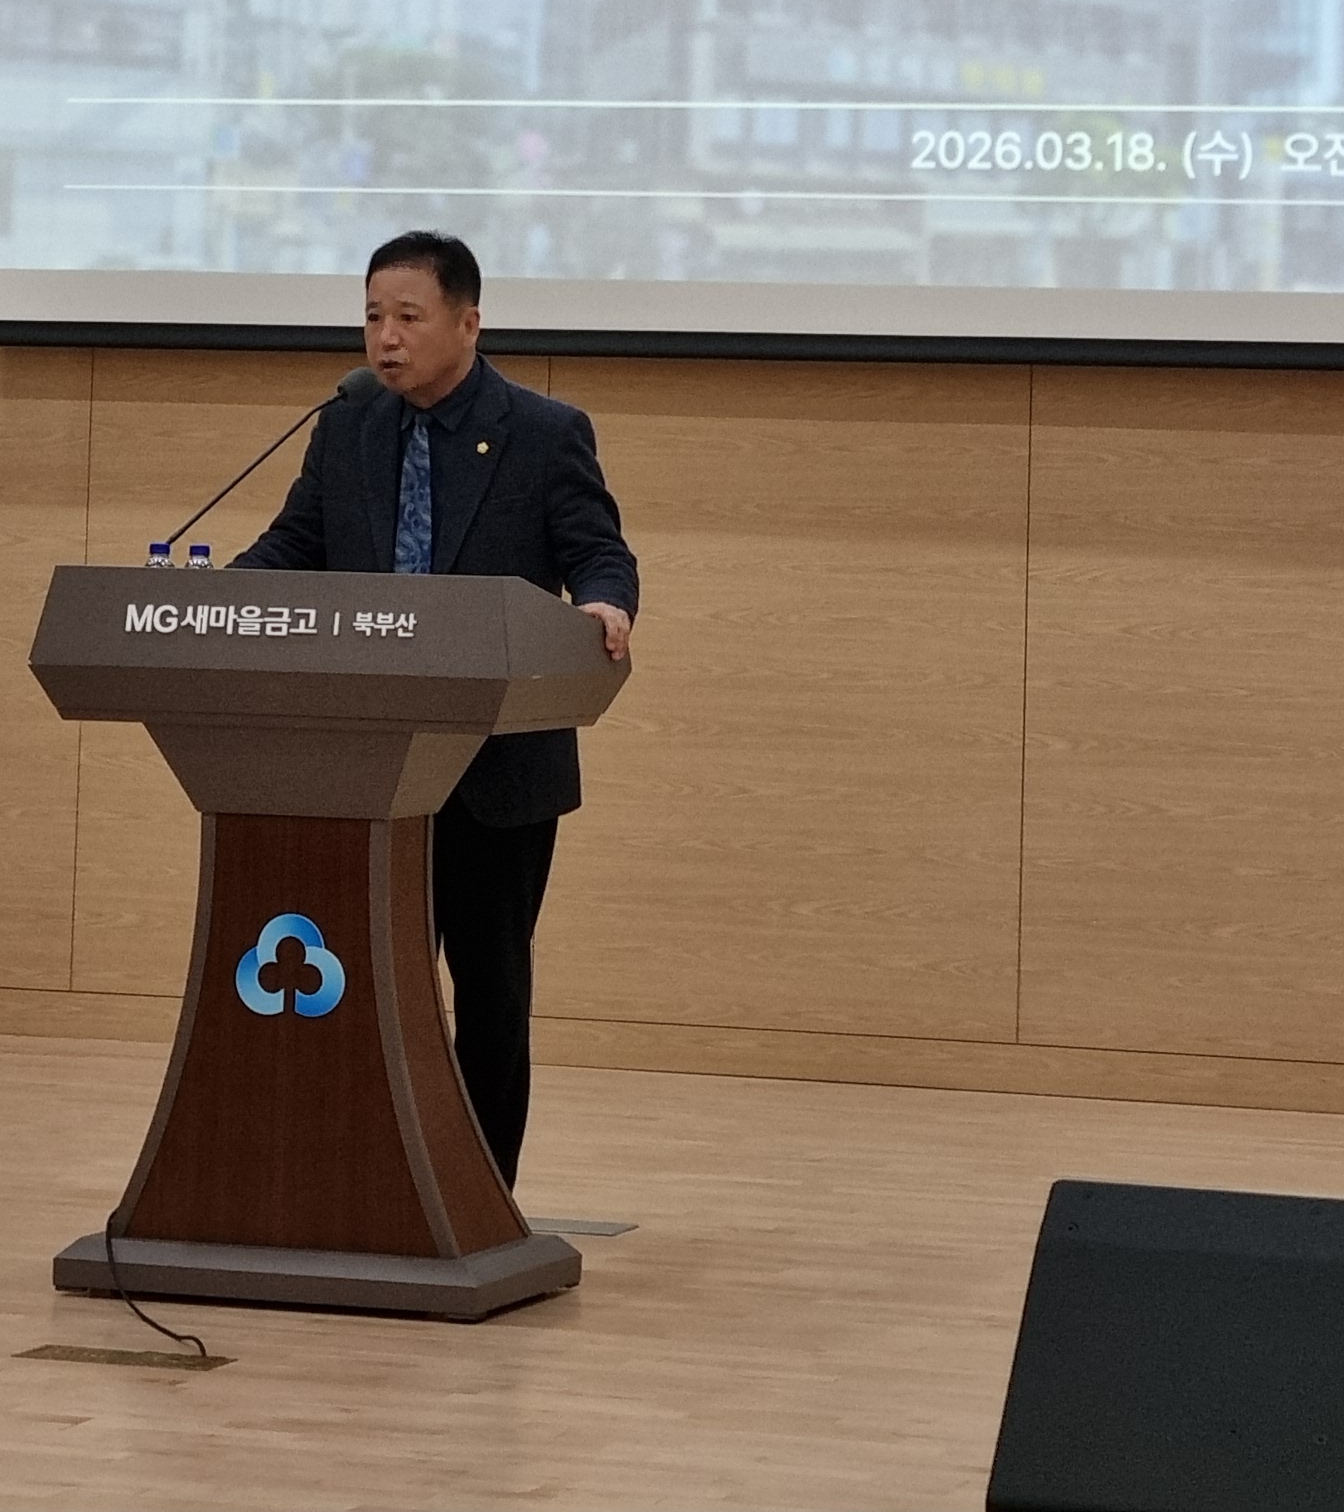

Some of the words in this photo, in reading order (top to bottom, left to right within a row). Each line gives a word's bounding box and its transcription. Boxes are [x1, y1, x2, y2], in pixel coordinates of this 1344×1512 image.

[910, 130, 1167, 172] 2026.03.18.
[1183, 131, 1255, 180] (수)
[125, 603, 317, 637] MG새마을금고
[352, 610, 417, 638] 북부산
